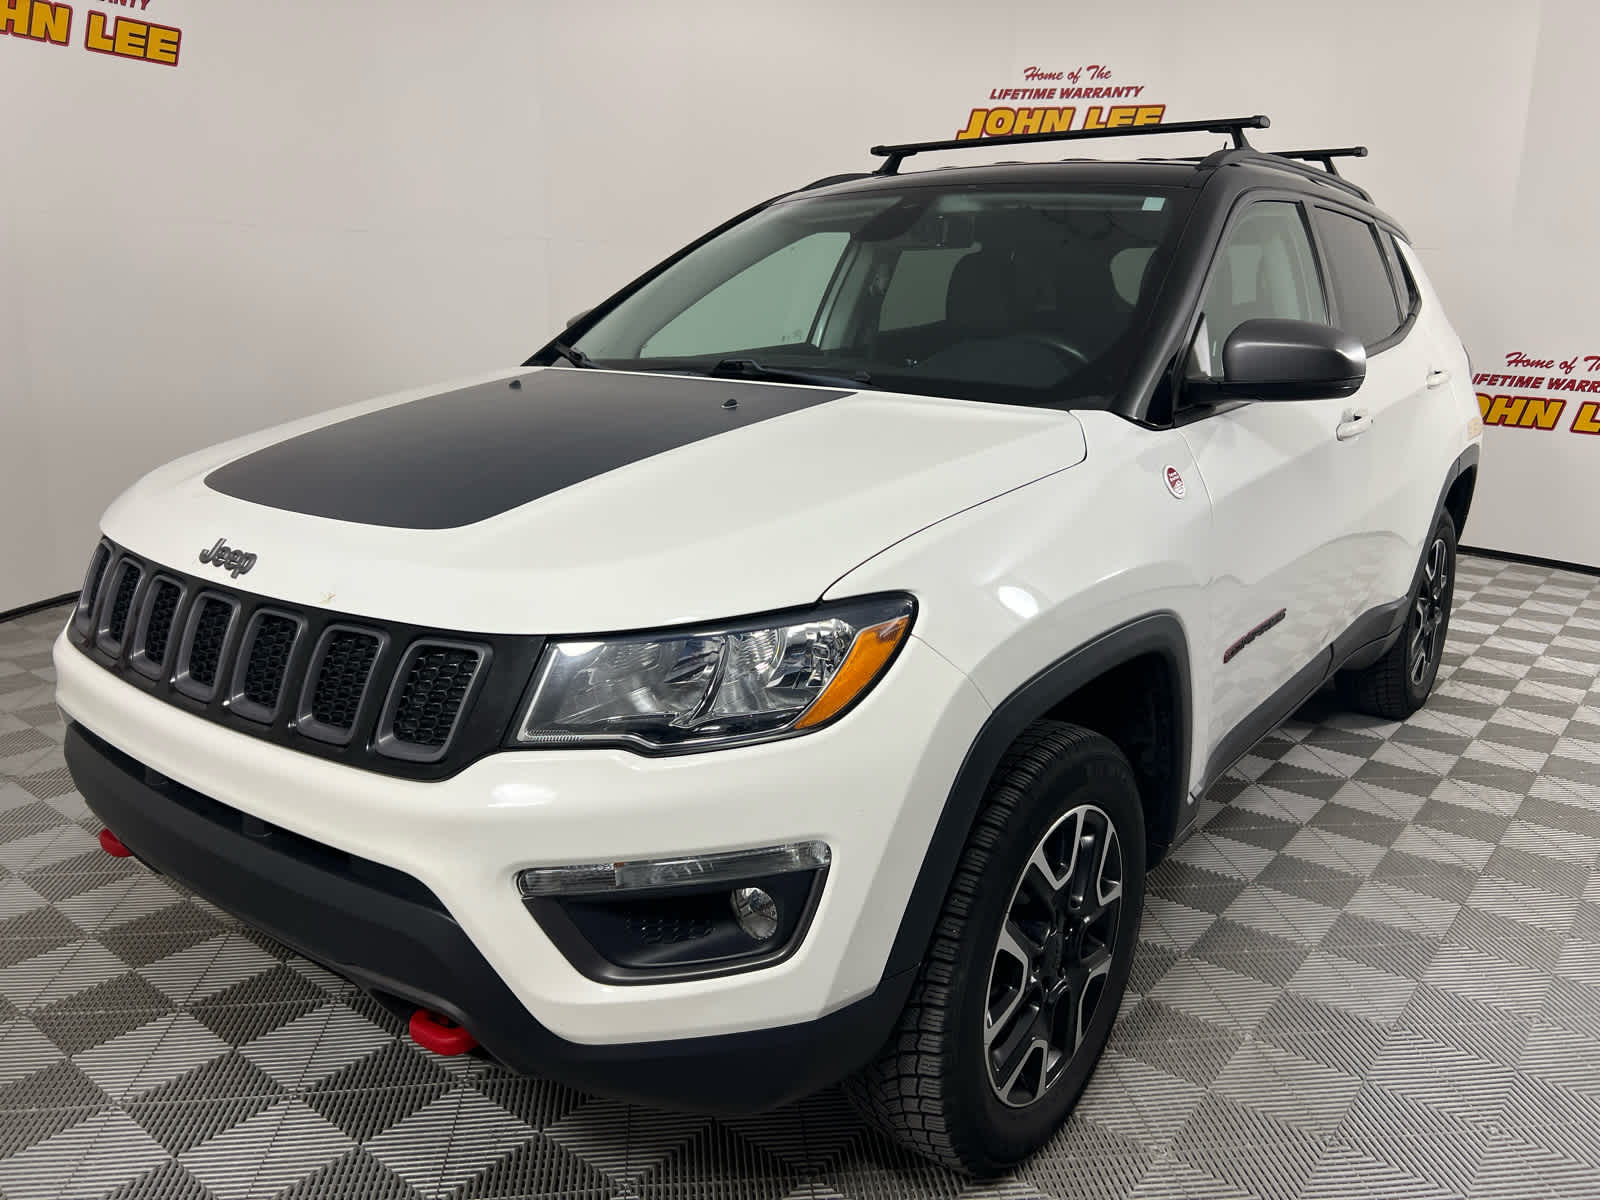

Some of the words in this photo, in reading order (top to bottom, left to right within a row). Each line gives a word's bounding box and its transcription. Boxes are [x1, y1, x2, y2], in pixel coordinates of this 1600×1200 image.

[85, 10, 182, 67] LEE
[1023, 65, 1064, 81] Home
[1066, 67, 1082, 84] of
[1086, 65, 1112, 80] The
[989, 87, 1057, 100] LIFETIME
[1059, 86, 1144, 99] WARRANTY
[955, 106, 1076, 140] JOHN
[1505, 352, 1554, 369] Home
[1559, 356, 1578, 374] of
[199, 538, 257, 579] Jeep
